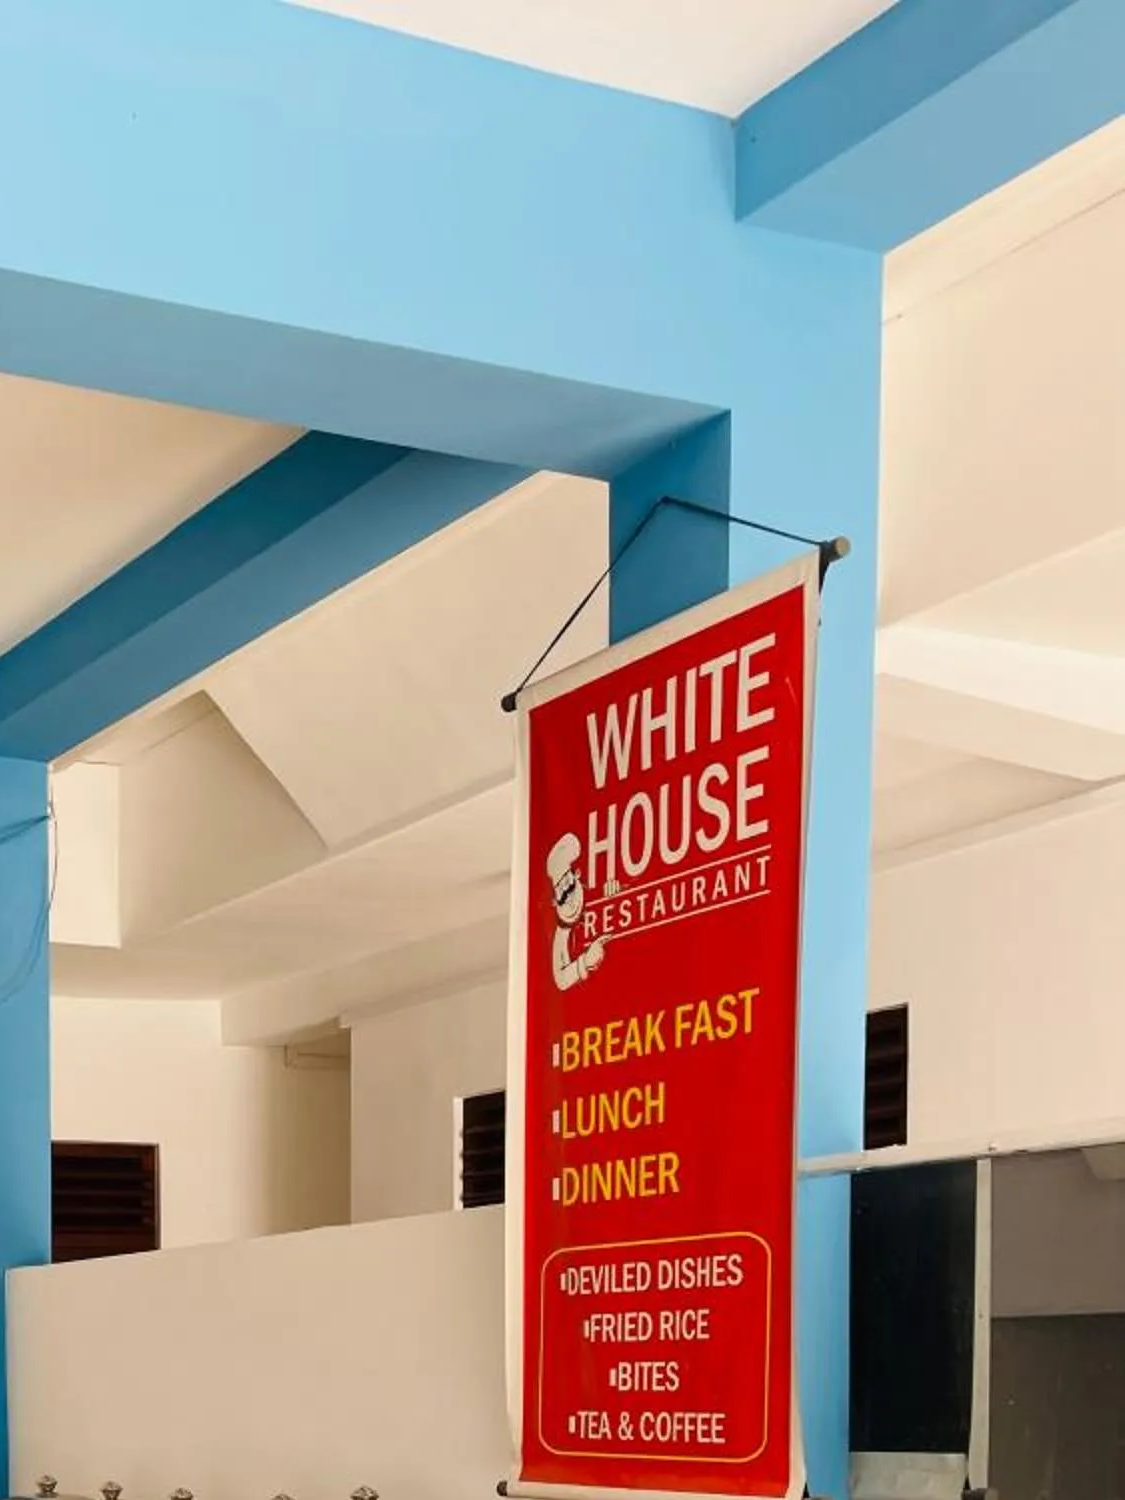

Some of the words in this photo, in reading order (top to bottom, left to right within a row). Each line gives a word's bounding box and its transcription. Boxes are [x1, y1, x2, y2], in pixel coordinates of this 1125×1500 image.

[586, 632, 776, 789] WHITE
[587, 746, 770, 889] HOUSE
[583, 856, 772, 938] RESTAURANT
[561, 1009, 666, 1072] BREAK
[674, 988, 760, 1050] FAST
[561, 1082, 666, 1139] LUNCH
[561, 1152, 680, 1207] DINNER
[567, 1261, 652, 1297] DEVILED
[658, 1254, 743, 1291] DISHES
[590, 1311, 654, 1344] FRIED
[659, 1308, 711, 1341] RICE
[618, 1361, 681, 1392] BITES
[577, 1410, 612, 1441] TEA
[618, 1412, 635, 1441] &
[640, 1410, 727, 1444] COFFEE
